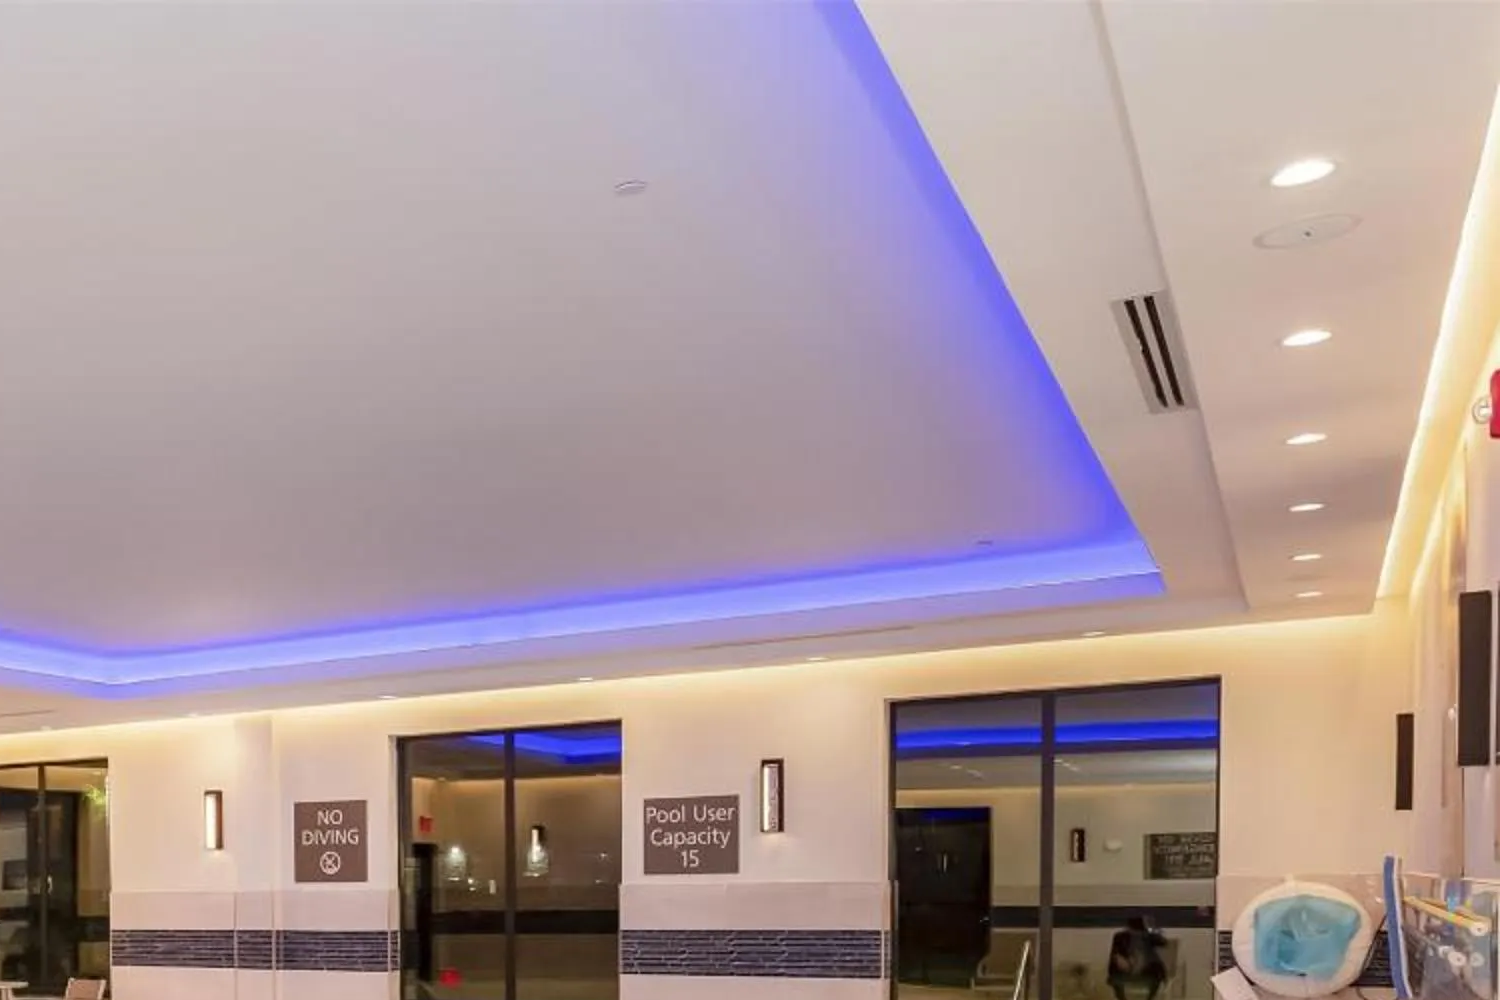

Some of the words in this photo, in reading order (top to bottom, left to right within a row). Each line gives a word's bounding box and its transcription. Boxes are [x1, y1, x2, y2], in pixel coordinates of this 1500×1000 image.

[317, 809, 343, 825] NO
[645, 804, 686, 824] Pool
[693, 804, 736, 822] User
[301, 829, 359, 845] DIVING
[650, 825, 731, 849] Capacity
[681, 849, 700, 868] 15
